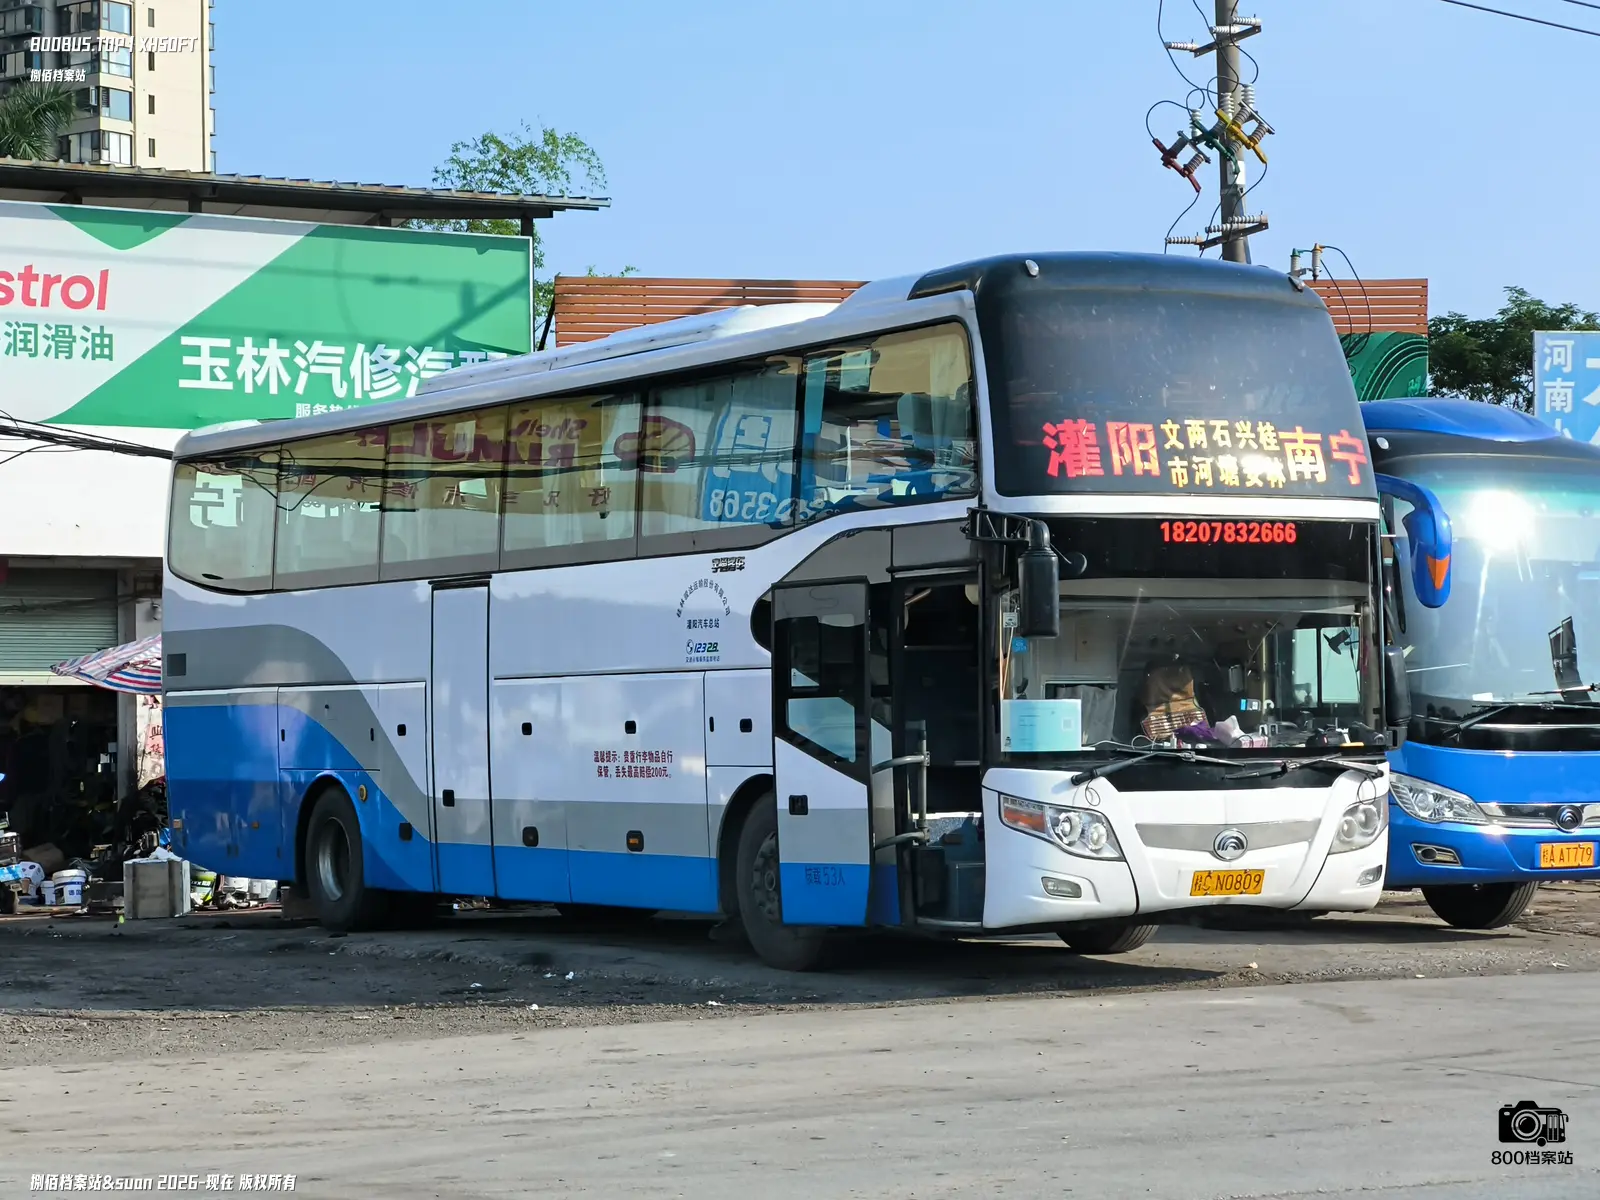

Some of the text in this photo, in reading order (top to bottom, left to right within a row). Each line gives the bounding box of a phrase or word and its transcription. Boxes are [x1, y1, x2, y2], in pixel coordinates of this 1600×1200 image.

[4, 320, 114, 362] 润滑油
[178, 336, 507, 400] 玉林汽修汽
[1042, 418, 1162, 478] 灌阳
[1279, 426, 1368, 486] 南宁
[1159, 520, 1297, 544] 18207832666
